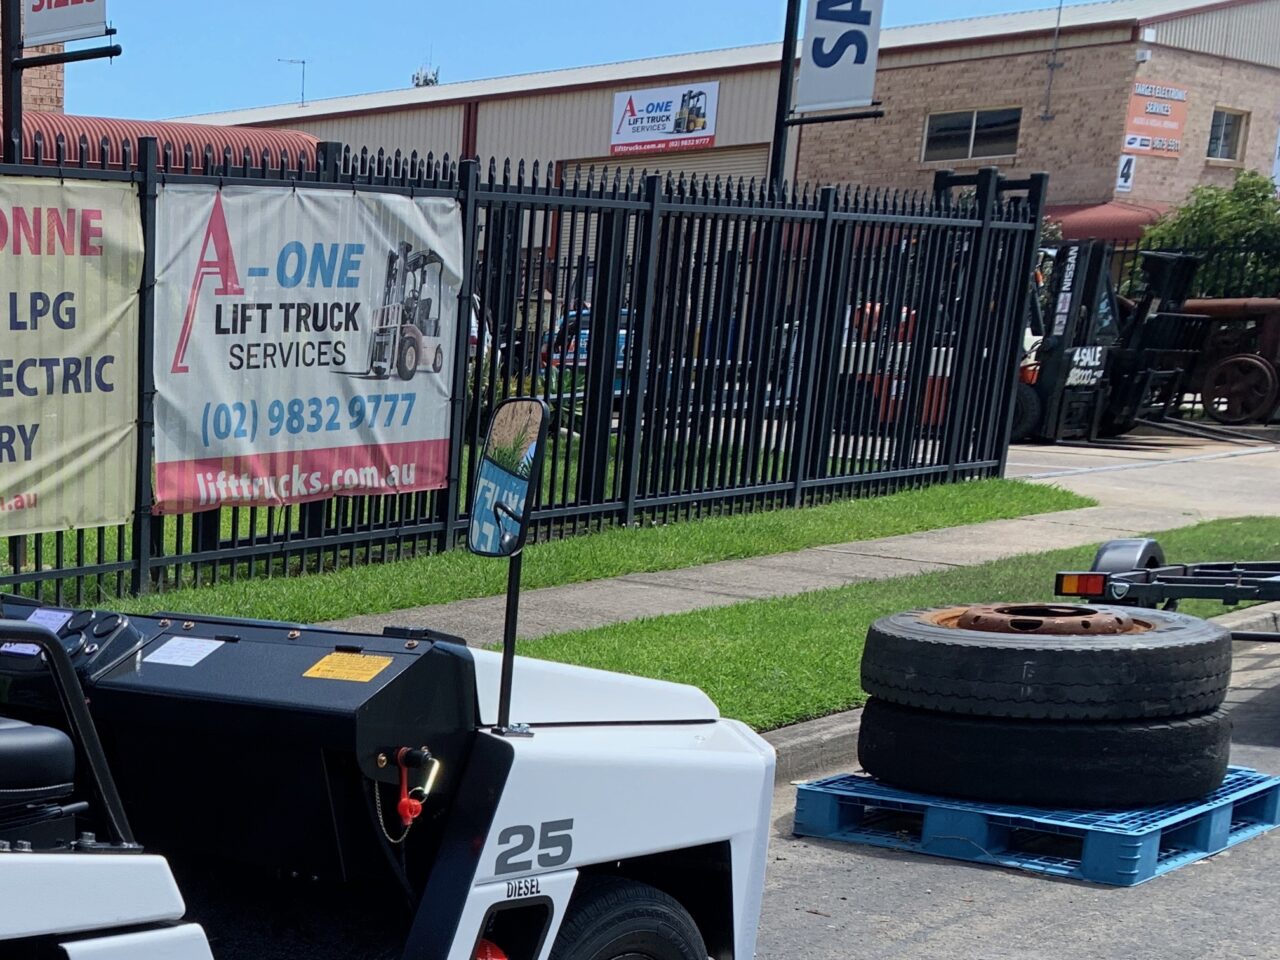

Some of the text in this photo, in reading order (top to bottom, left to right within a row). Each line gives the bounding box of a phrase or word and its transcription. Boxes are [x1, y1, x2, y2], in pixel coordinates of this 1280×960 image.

[628, 114, 671, 126] LIFT TRUCK
[631, 123, 667, 134] SERVICES
[1120, 157, 1133, 184] 4
[1061, 245, 1079, 292] NISSAN
[9, 291, 76, 331] LPG
[215, 302, 361, 335] LIFT TRUCK
[229, 340, 347, 371] SERVICES
[201, 392, 417, 448] (02) 9832 9777
[196, 462, 417, 505] lifttrucks.com.au
[494, 818, 574, 876] 25
[506, 878, 541, 898] DIESEL
